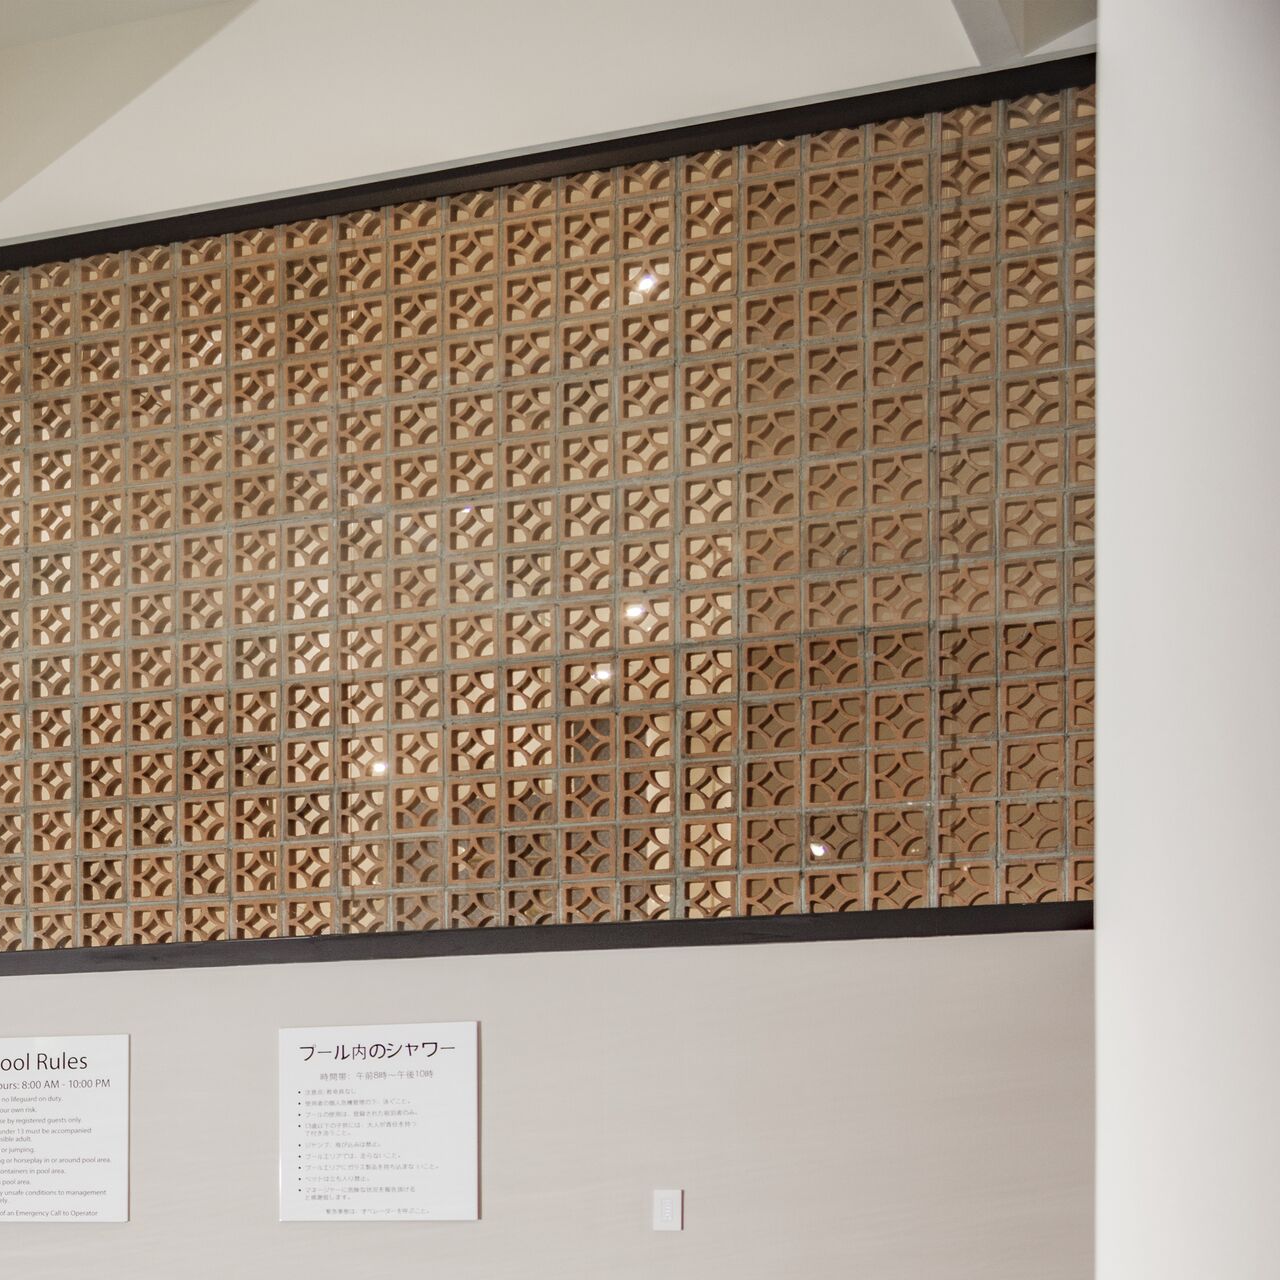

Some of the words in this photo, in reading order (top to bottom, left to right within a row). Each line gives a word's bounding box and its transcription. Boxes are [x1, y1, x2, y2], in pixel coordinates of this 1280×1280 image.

[37, 1052, 88, 1070] Rules
[22, 1080, 41, 1089] 8:00
[44, 1080, 60, 1089] AM
[69, 1079, 92, 1088] 10:00
[95, 1079, 110, 1088] PM
[0, 1209, 6, 1217] of
[6, 1209, 14, 1217] an
[16, 1209, 49, 1217] Emergency
[50, 1209, 62, 1217] Call
[63, 1209, 69, 1217] to
[70, 1209, 98, 1217] Operator
